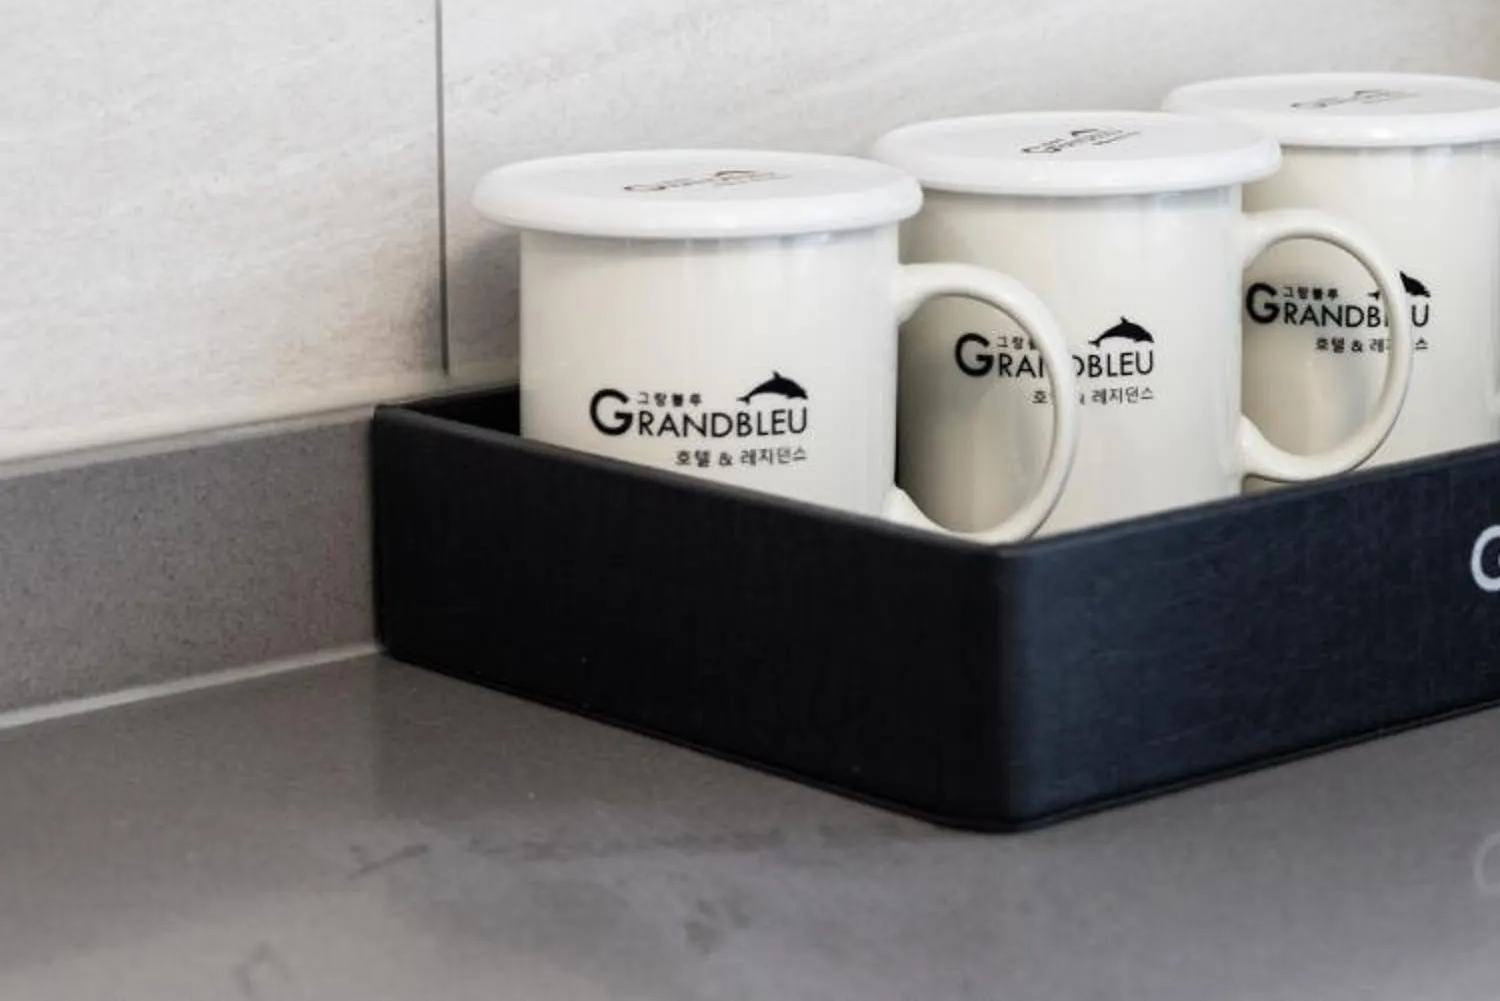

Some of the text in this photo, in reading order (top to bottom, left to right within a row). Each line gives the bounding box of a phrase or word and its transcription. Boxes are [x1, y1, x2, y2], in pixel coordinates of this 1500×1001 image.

[1246, 282, 1430, 327] GRANDBU
[1369, 336, 1429, 353] 레스
[1091, 386, 1154, 405] 레지던스
[590, 388, 808, 437] GRANDBLEU
[676, 447, 808, 467] 호텔 & 레지던스
